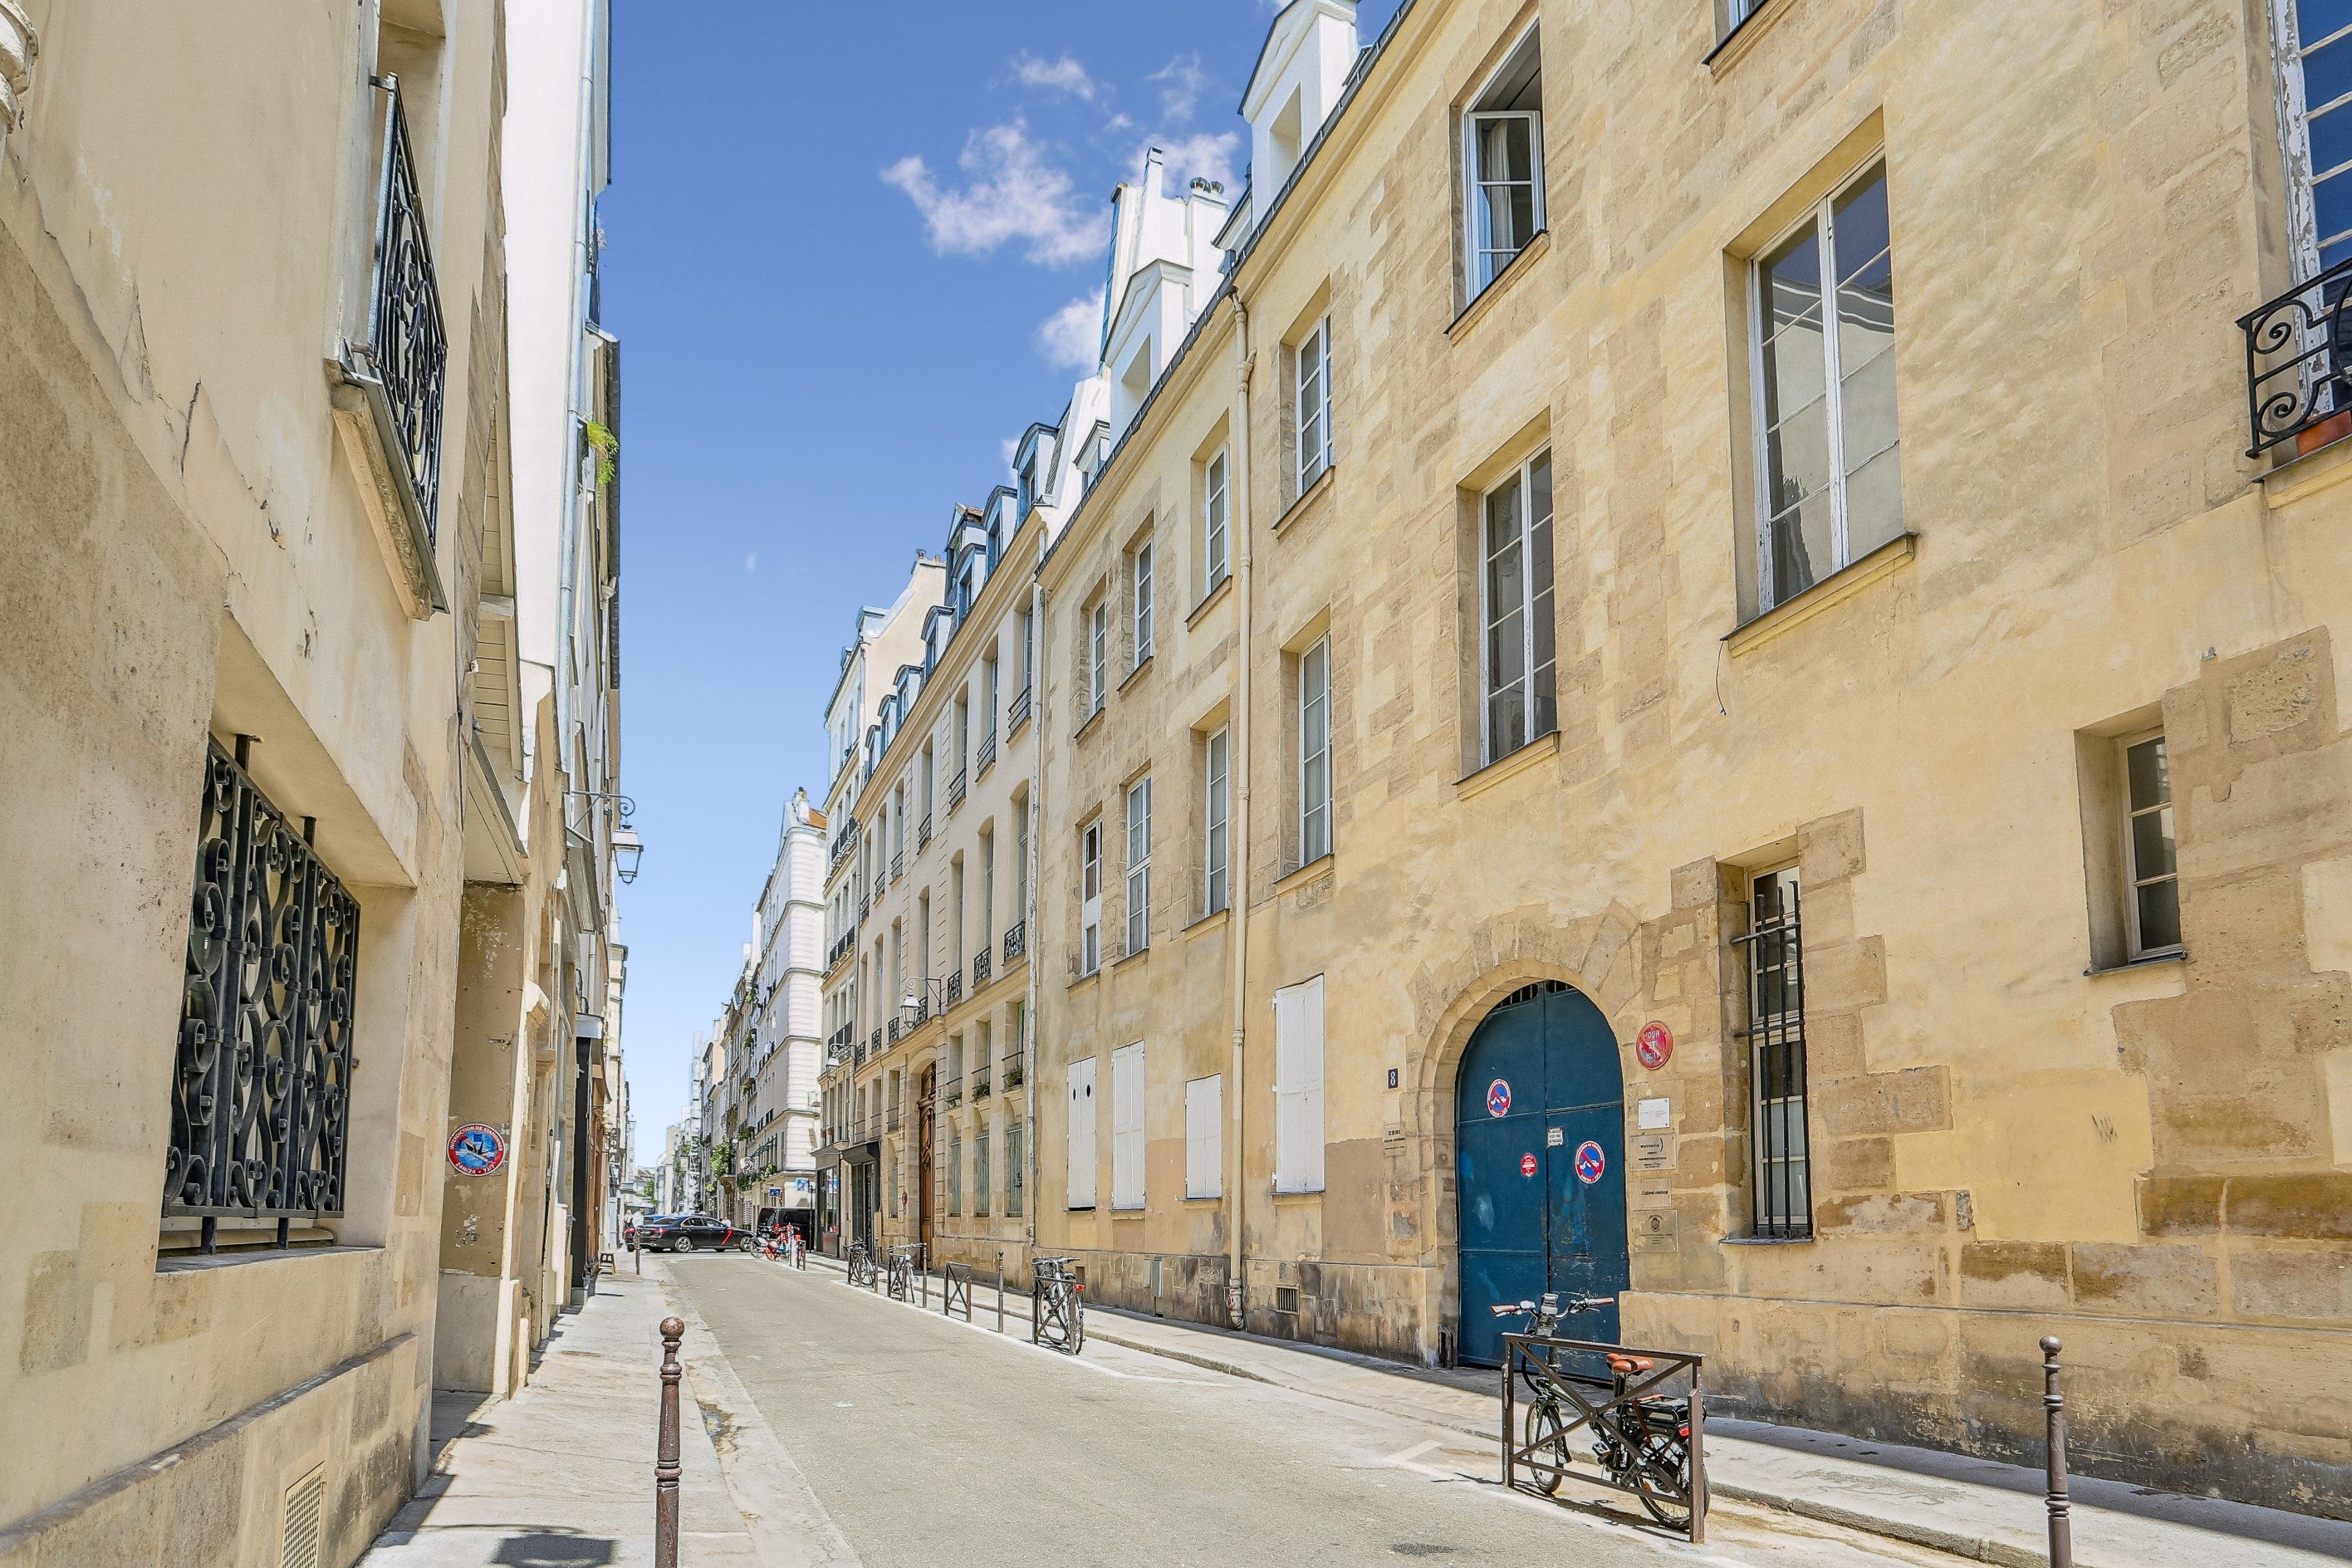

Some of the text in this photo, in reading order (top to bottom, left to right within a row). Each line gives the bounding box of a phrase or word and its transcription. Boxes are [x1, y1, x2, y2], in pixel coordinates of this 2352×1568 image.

[1645, 1030, 1660, 1038] JOUR
[1390, 1071, 1395, 1085] 8
[449, 1126, 474, 1149] INTERDICTION
[483, 1127, 502, 1151] STATIONNER
[455, 1162, 495, 1174] 24H/24 7J/7
